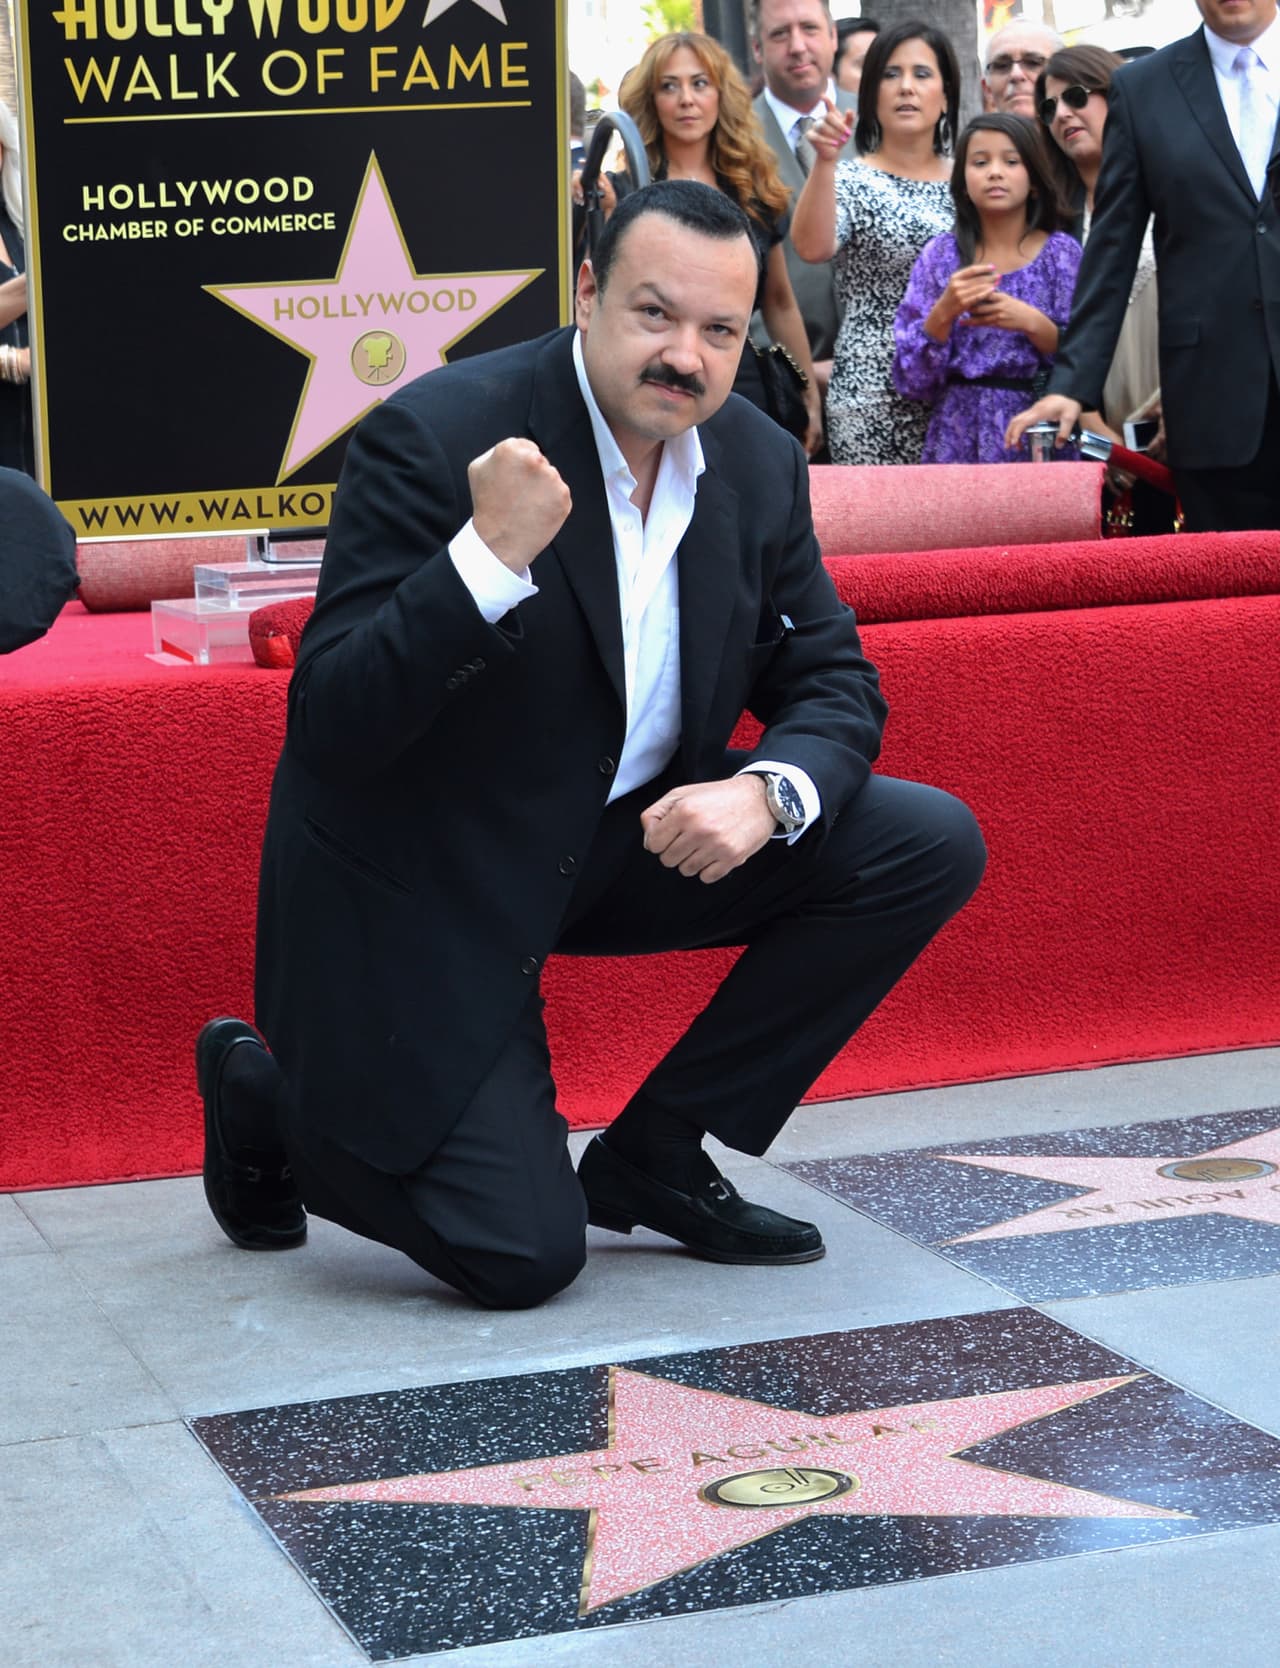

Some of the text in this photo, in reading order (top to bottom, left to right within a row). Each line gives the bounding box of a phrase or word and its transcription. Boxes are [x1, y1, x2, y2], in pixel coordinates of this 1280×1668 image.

[64, 41, 530, 104] WALK OF FAME
[82, 176, 315, 211] HOLLYWOOD
[62, 212, 336, 242] CHAMBER OF COMMERCE
[273, 288, 477, 321] HOLLYWOOD
[79, 491, 336, 530] WWW.WALKO
[1056, 1189, 1246, 1219] AGUILAR
